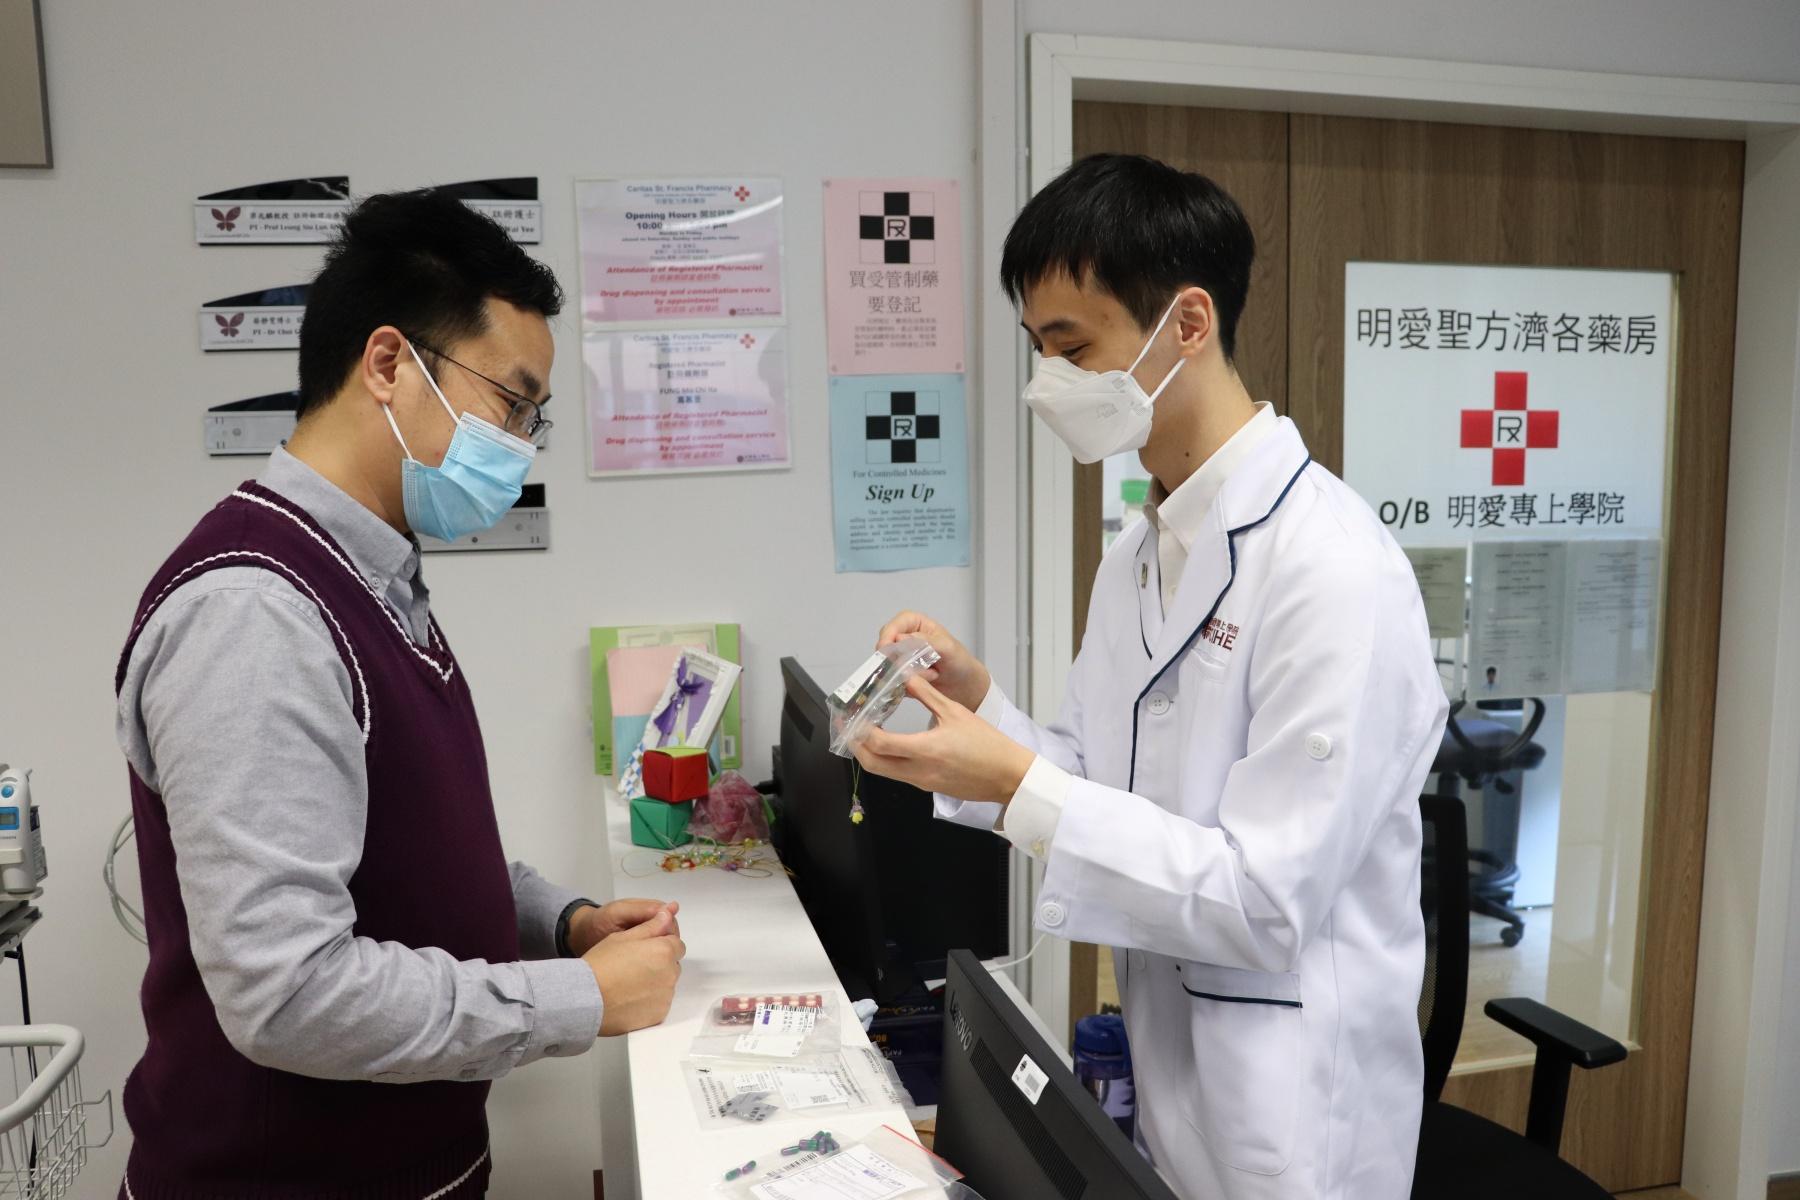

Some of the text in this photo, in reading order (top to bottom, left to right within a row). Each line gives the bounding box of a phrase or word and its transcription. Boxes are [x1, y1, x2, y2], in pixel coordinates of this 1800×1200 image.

[666, 184, 694, 192] Francis
[696, 184, 732, 192] Pharmacy
[625, 210, 698, 221] Opening Hours
[606, 266, 656, 274] Attendance
[668, 265, 714, 274] Registered
[716, 264, 763, 272] Pharmacist
[849, 270, 939, 289] 買受管制藥
[600, 289, 620, 298] Drug
[622, 288, 668, 298] dispensing
[687, 287, 739, 295] consultation
[667, 296, 719, 305] appointment
[868, 295, 923, 314] 要登記
[1357, 306, 1658, 356] 明愛聖方濟各藥房
[720, 409, 768, 418] Pharmacist
[606, 437, 626, 445] Drug
[853, 468, 946, 478] For Controlled Medicines
[865, 482, 935, 504] Sign Up
[1379, 492, 1625, 529] O/B 明愛專上學院
